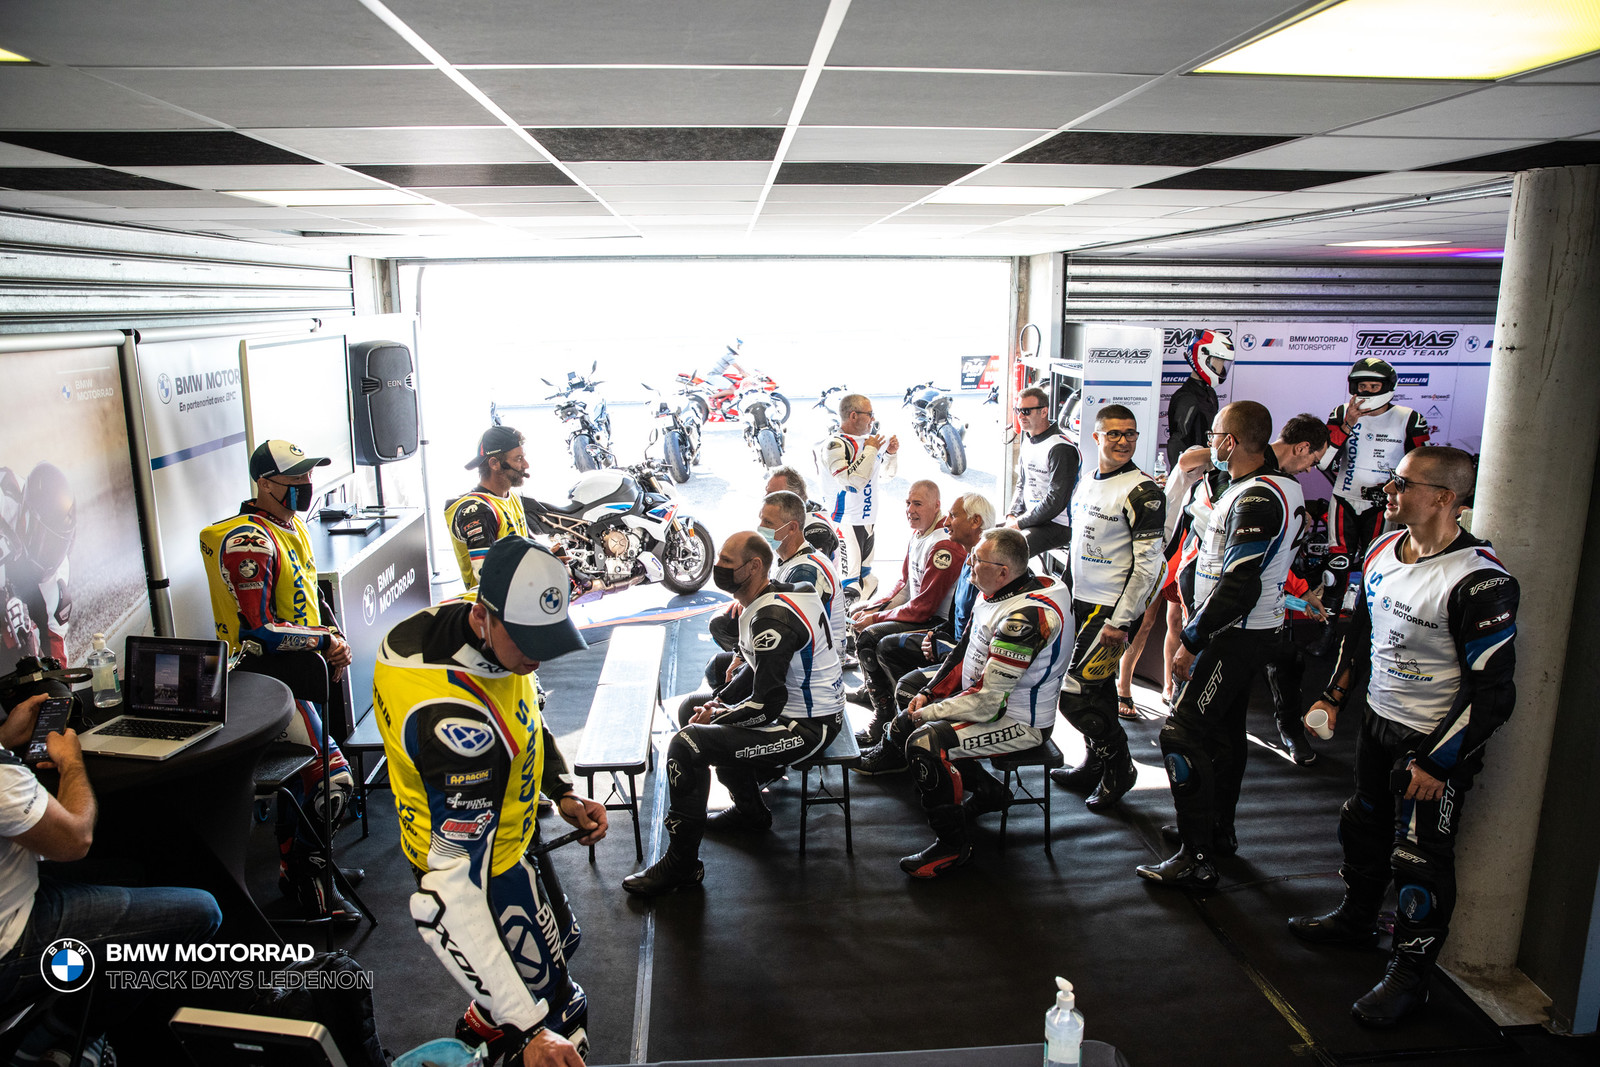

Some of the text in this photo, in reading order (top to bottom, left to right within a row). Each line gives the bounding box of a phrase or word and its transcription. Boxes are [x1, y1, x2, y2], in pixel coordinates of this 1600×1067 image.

[1289, 335, 1349, 343] BMW MOTORRAD
[1356, 329, 1459, 350] TECMAS
[1088, 347, 1152, 360] TECMAS
[1288, 343, 1336, 351] MOTORSPORT
[1412, 349, 1449, 357] TEAM
[75, 378, 93, 390] BMW
[175, 368, 241, 396] BMW MOTOR
[387, 380, 402, 388] EON
[76, 387, 114, 400] MOTORRAD
[179, 402, 186, 412] En
[186, 396, 213, 413] partenariat
[213, 394, 225, 404] avec
[1088, 510, 1119, 522] MOTORRAD
[1081, 555, 1112, 565] MICHELIN
[377, 562, 395, 593] BMW
[288, 548, 308, 627] CKDAYS
[379, 567, 415, 614] MOTORRAD
[1394, 600, 1412, 613] BMW
[1392, 608, 1439, 629] MOTORRAD
[818, 611, 833, 651] 1
[1389, 628, 1405, 640] MAKE
[1388, 635, 1400, 643] LIFE
[1386, 668, 1434, 682] MICHELIN
[1198, 660, 1223, 714] RST
[735, 735, 805, 759] alpinestars
[465, 770, 489, 781] RACING
[435, 921, 492, 997] XON
